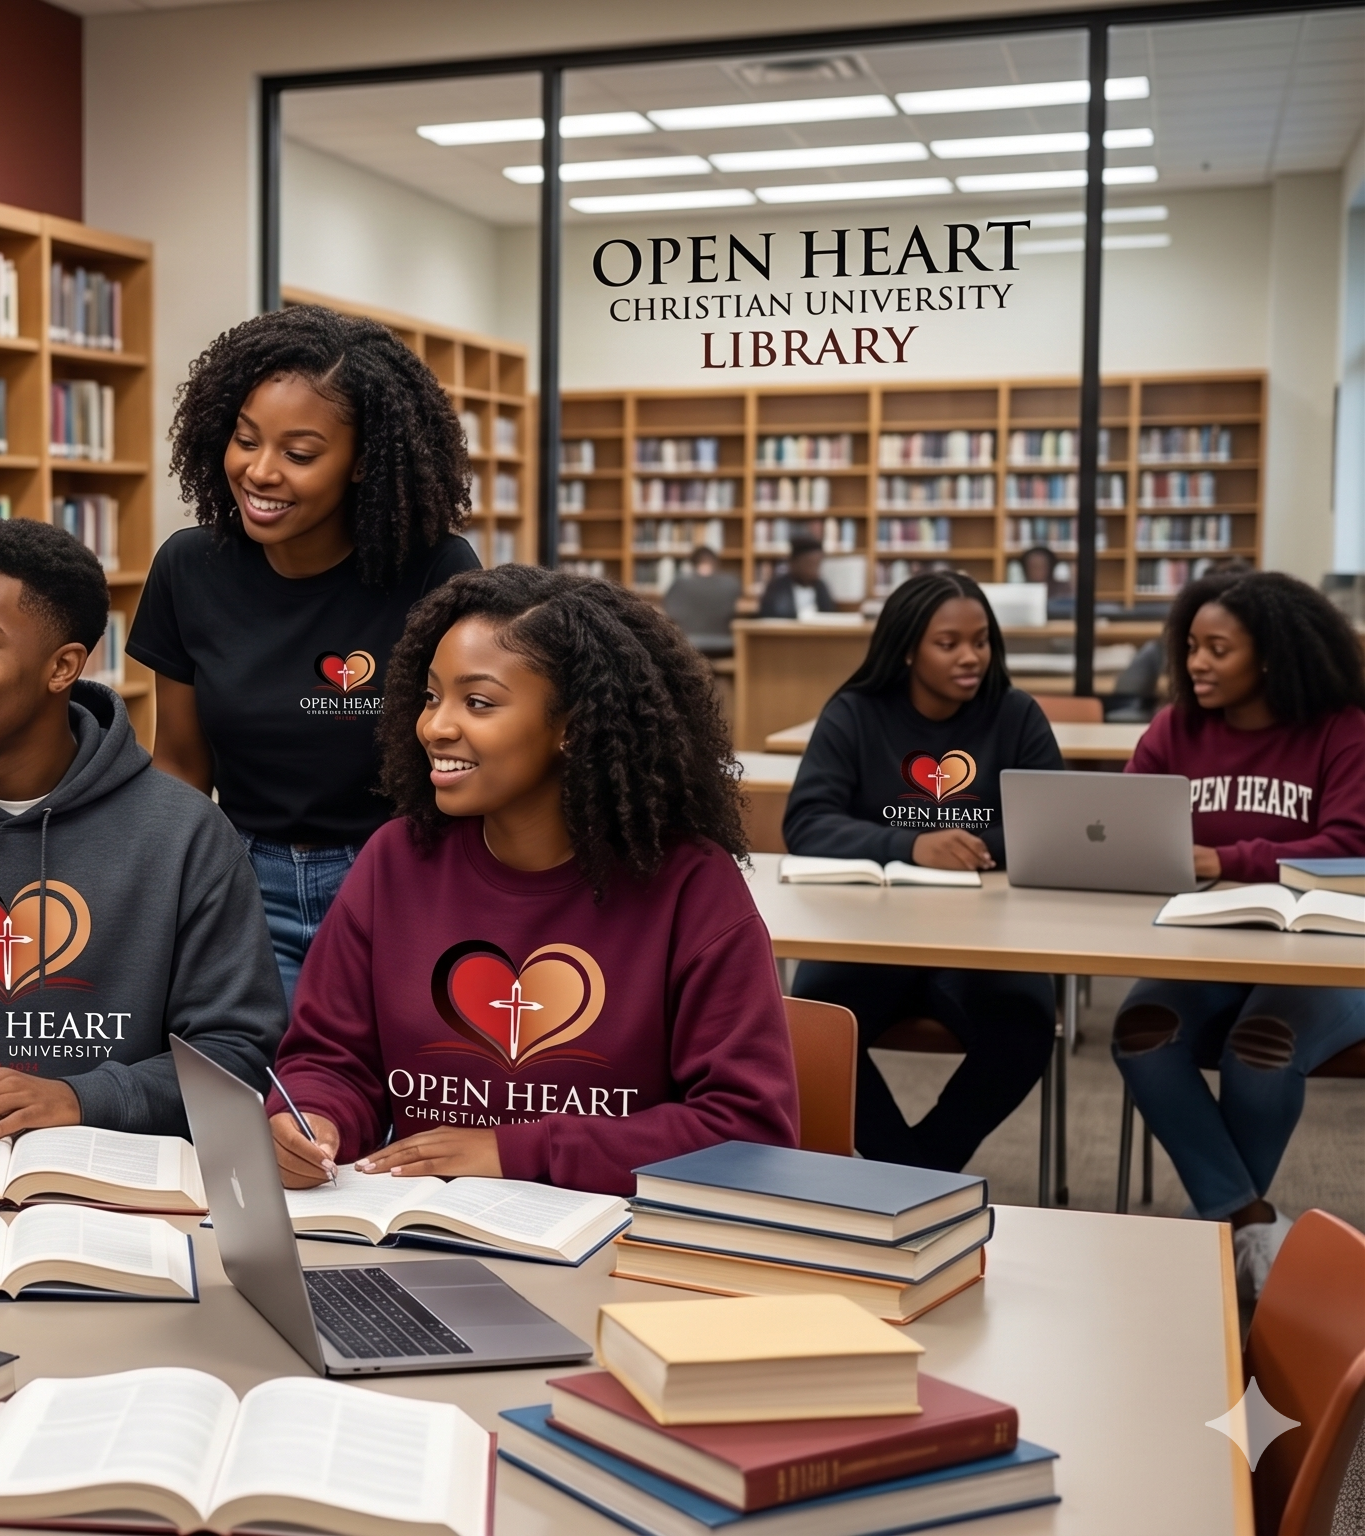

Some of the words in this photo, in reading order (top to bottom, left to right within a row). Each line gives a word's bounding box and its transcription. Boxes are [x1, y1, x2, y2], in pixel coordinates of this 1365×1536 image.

[592, 232, 776, 288] OPEN
[800, 220, 1032, 279] HEART
[609, 292, 793, 322] CHRISTIAN
[805, 283, 1014, 315] UNIVERSITY
[700, 325, 920, 369] LIBRARY
[299, 697, 339, 709] OPEN
[882, 805, 931, 820] OPEN
[937, 807, 995, 821] HEART
[1190, 775, 1233, 813] PEN
[1234, 775, 1313, 824] HEART
[5, 1011, 132, 1040] HEART
[9, 1045, 113, 1058] UNIVERSITY
[387, 1068, 492, 1109] OPEN
[505, 1081, 639, 1118] HEART
[404, 1105, 501, 1127] CHRISTIAN
